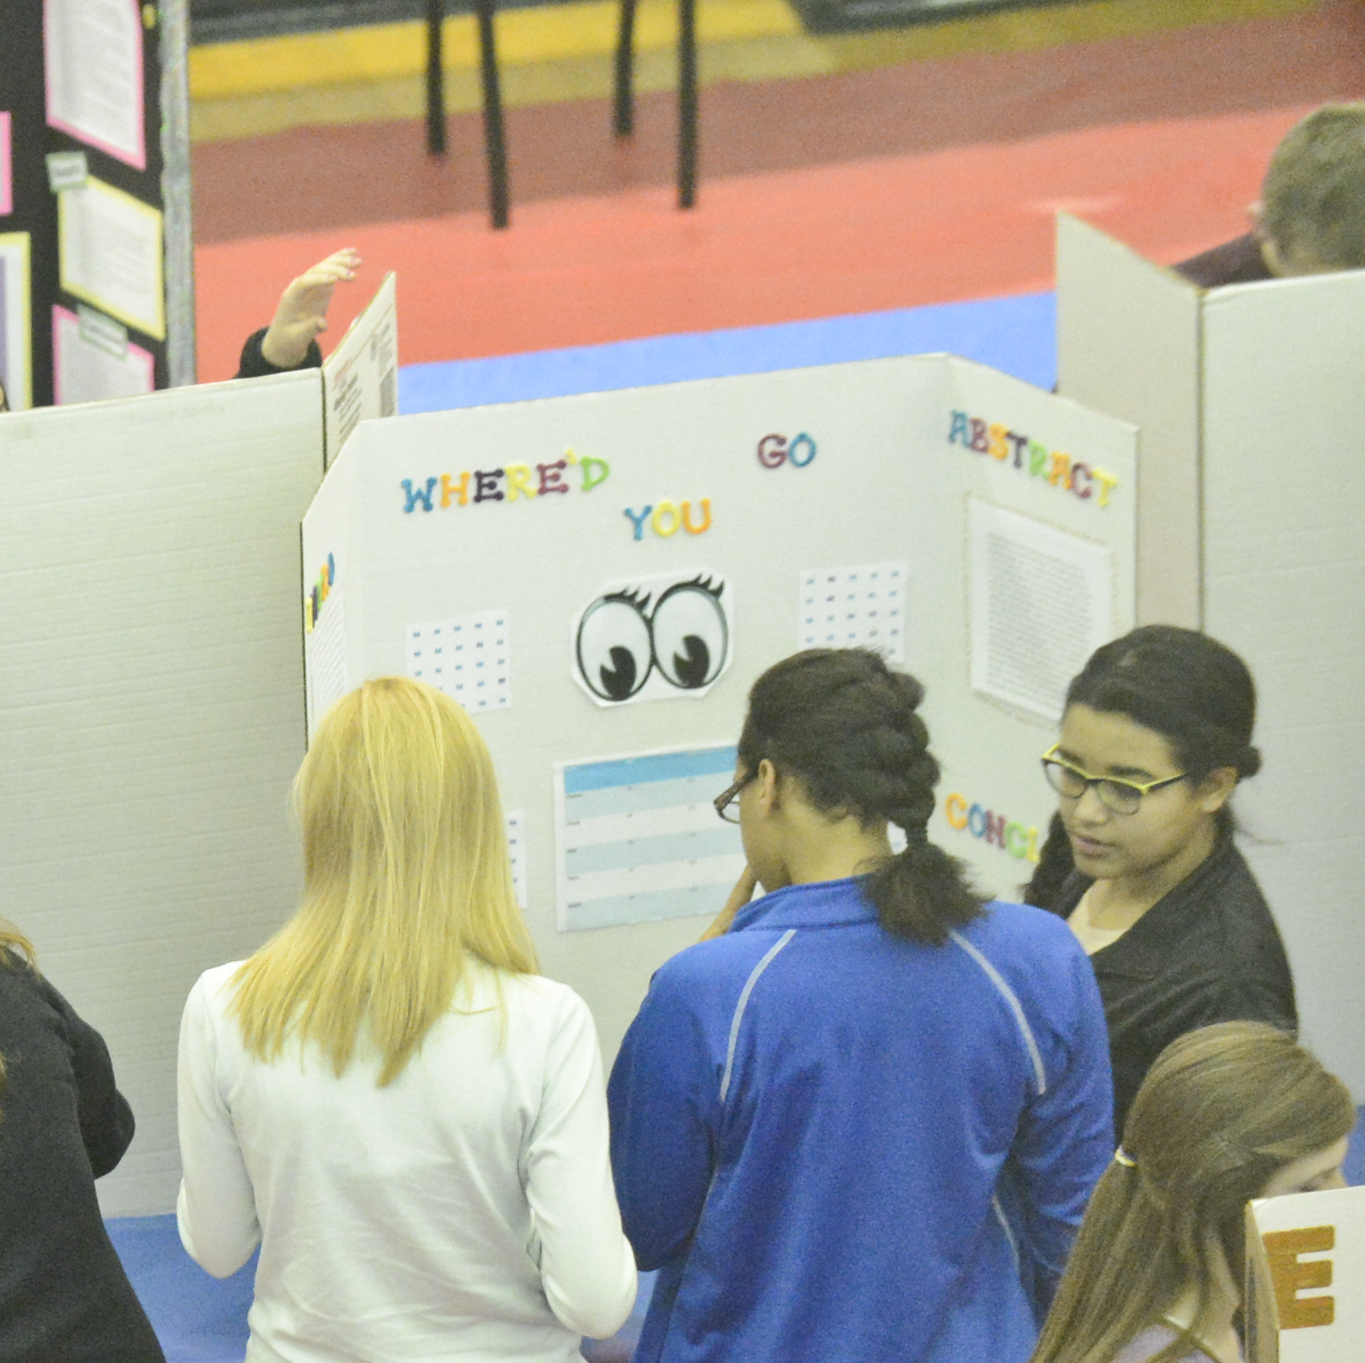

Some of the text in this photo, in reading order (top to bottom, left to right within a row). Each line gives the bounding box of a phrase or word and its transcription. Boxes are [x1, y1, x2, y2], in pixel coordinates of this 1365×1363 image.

[401, 449, 610, 513] WHERE'D
[757, 433, 816, 469] GO
[949, 409, 1119, 509] ABSTRACT
[623, 499, 712, 540] YOU
[1275, 1224, 1336, 1330] E
